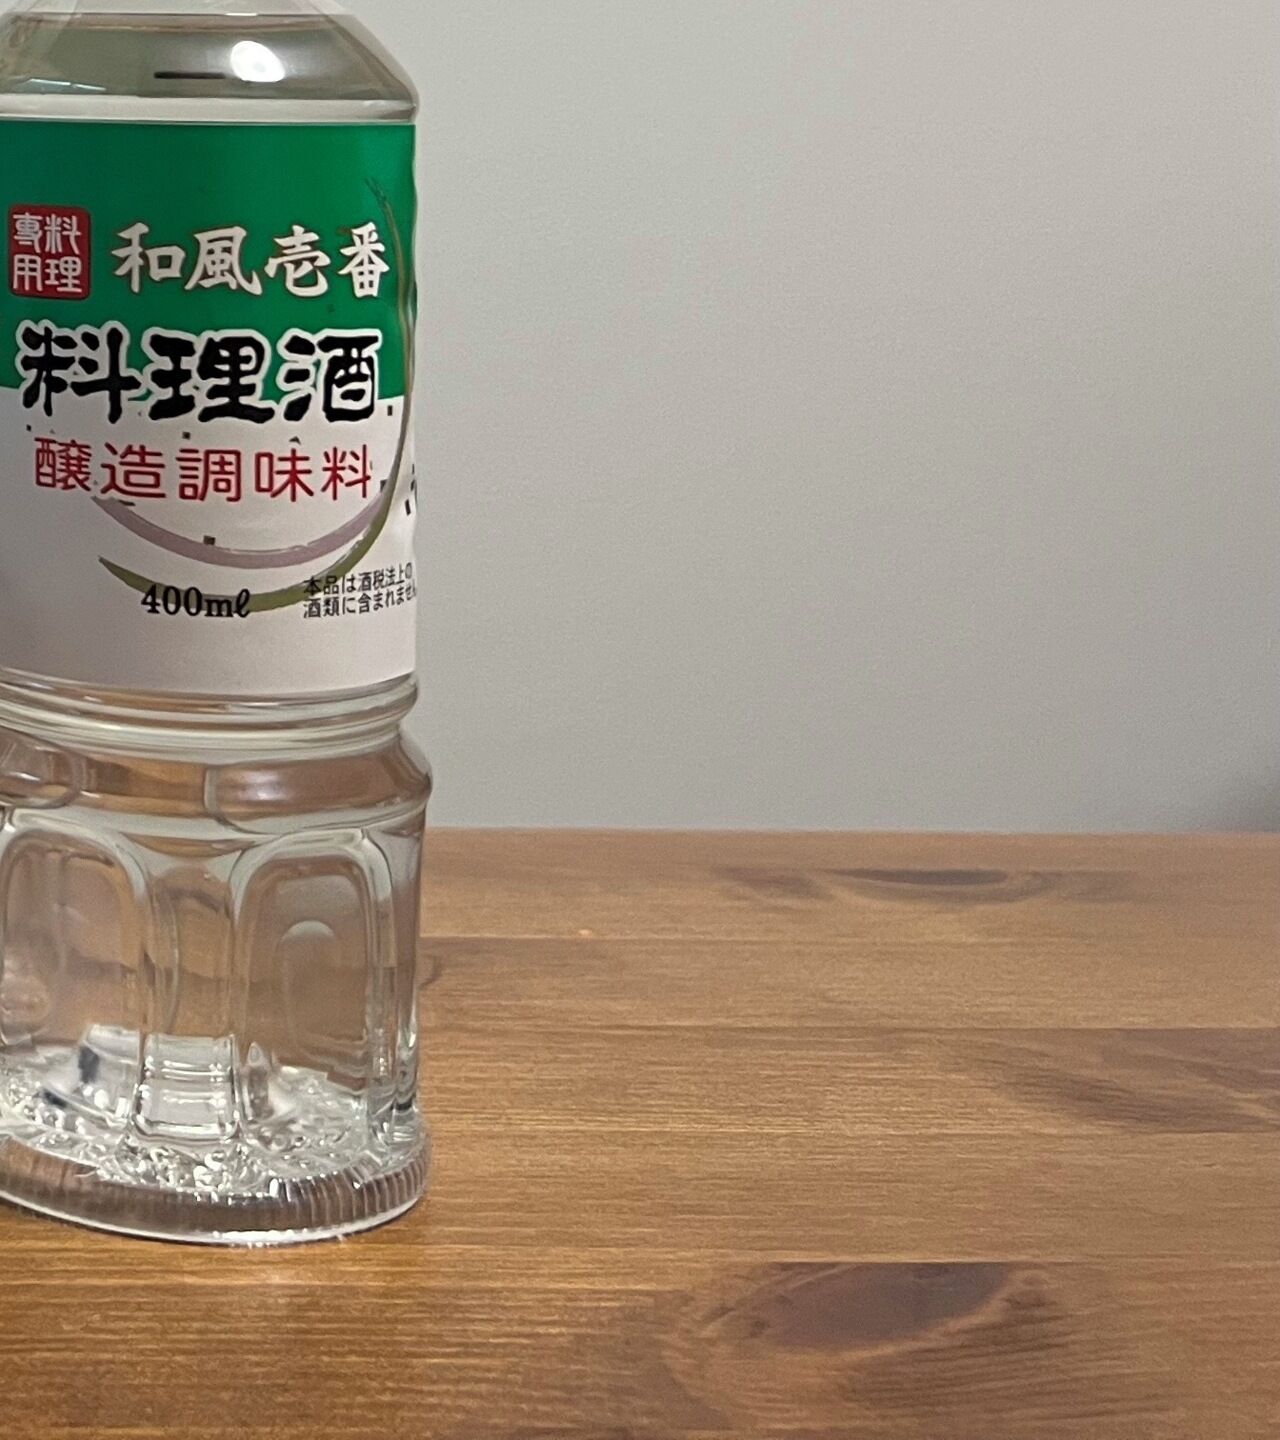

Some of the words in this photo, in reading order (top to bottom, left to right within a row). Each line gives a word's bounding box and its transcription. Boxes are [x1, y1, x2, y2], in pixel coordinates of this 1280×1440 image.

[110, 221, 391, 298] 和風壱番
[20, 324, 380, 424] 料理酒
[33, 436, 372, 503] 醸造調味料
